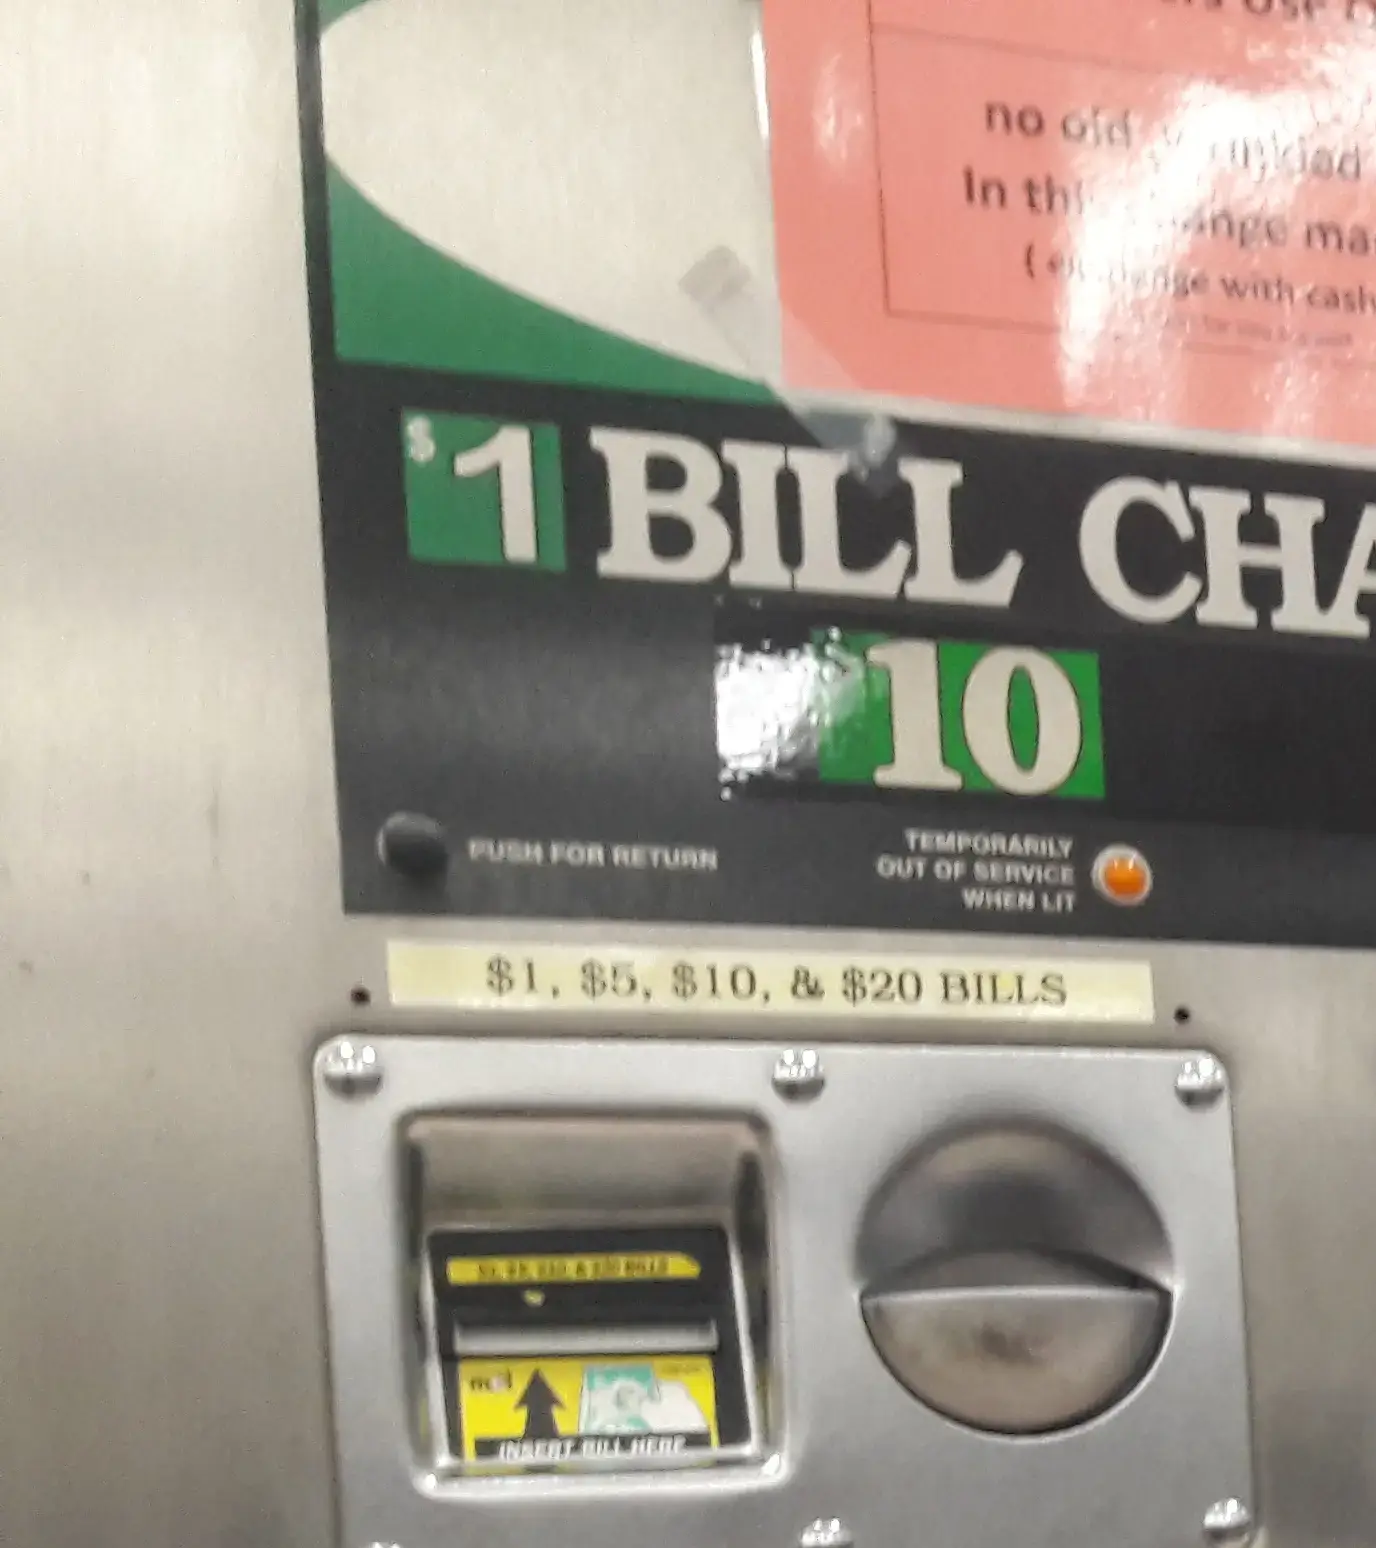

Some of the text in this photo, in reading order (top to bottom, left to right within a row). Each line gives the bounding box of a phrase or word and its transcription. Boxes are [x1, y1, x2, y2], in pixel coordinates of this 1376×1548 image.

[984, 100, 1045, 138] no
[1024, 170, 1098, 216] thi
[1218, 270, 1297, 305] with
[588, 424, 1024, 608] BILL
[468, 838, 719, 871] PUSH FOR RETURN
[904, 827, 1074, 859] TEMPORARILY
[875, 853, 1075, 886] OUT OF SERVICE
[961, 886, 1075, 913] WHEN LIT
[486, 953, 1068, 1007] $1, $5, $10, & $20 BILLS
